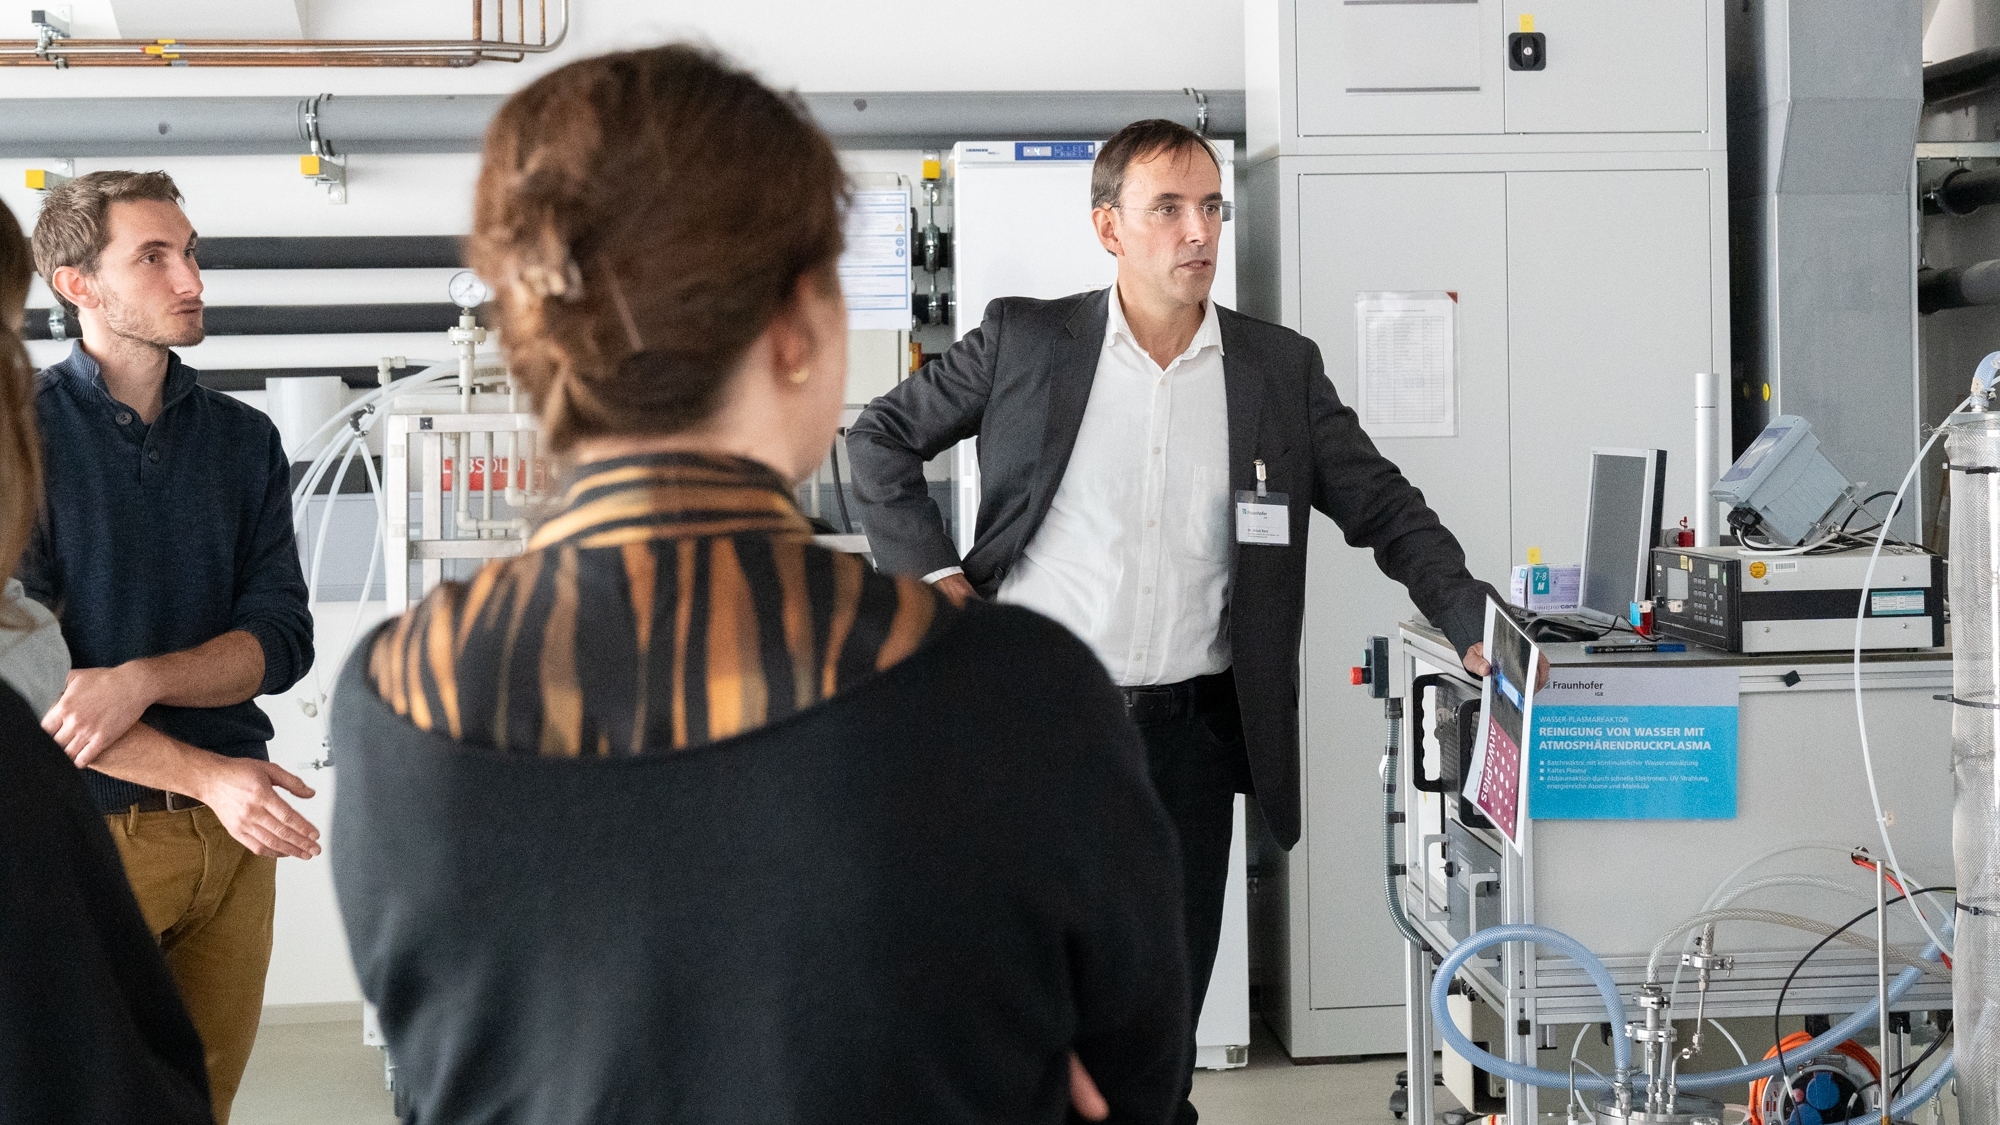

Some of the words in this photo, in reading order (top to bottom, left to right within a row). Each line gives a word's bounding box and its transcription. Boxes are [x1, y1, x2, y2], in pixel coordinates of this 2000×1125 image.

[1535, 572, 1547, 581] 7-8
[1537, 582, 1545, 591] M
[1552, 681, 1604, 690] Fraunhofer
[1539, 727, 1603, 737] REINIGUNG
[1606, 727, 1631, 737] VON
[1634, 727, 1681, 737] WASSER
[1684, 727, 1705, 737] MIT
[1538, 739, 1712, 750] ATMOSPHÄRENDRUCKPLASMA
[1480, 722, 1497, 803] AtWaPlas
